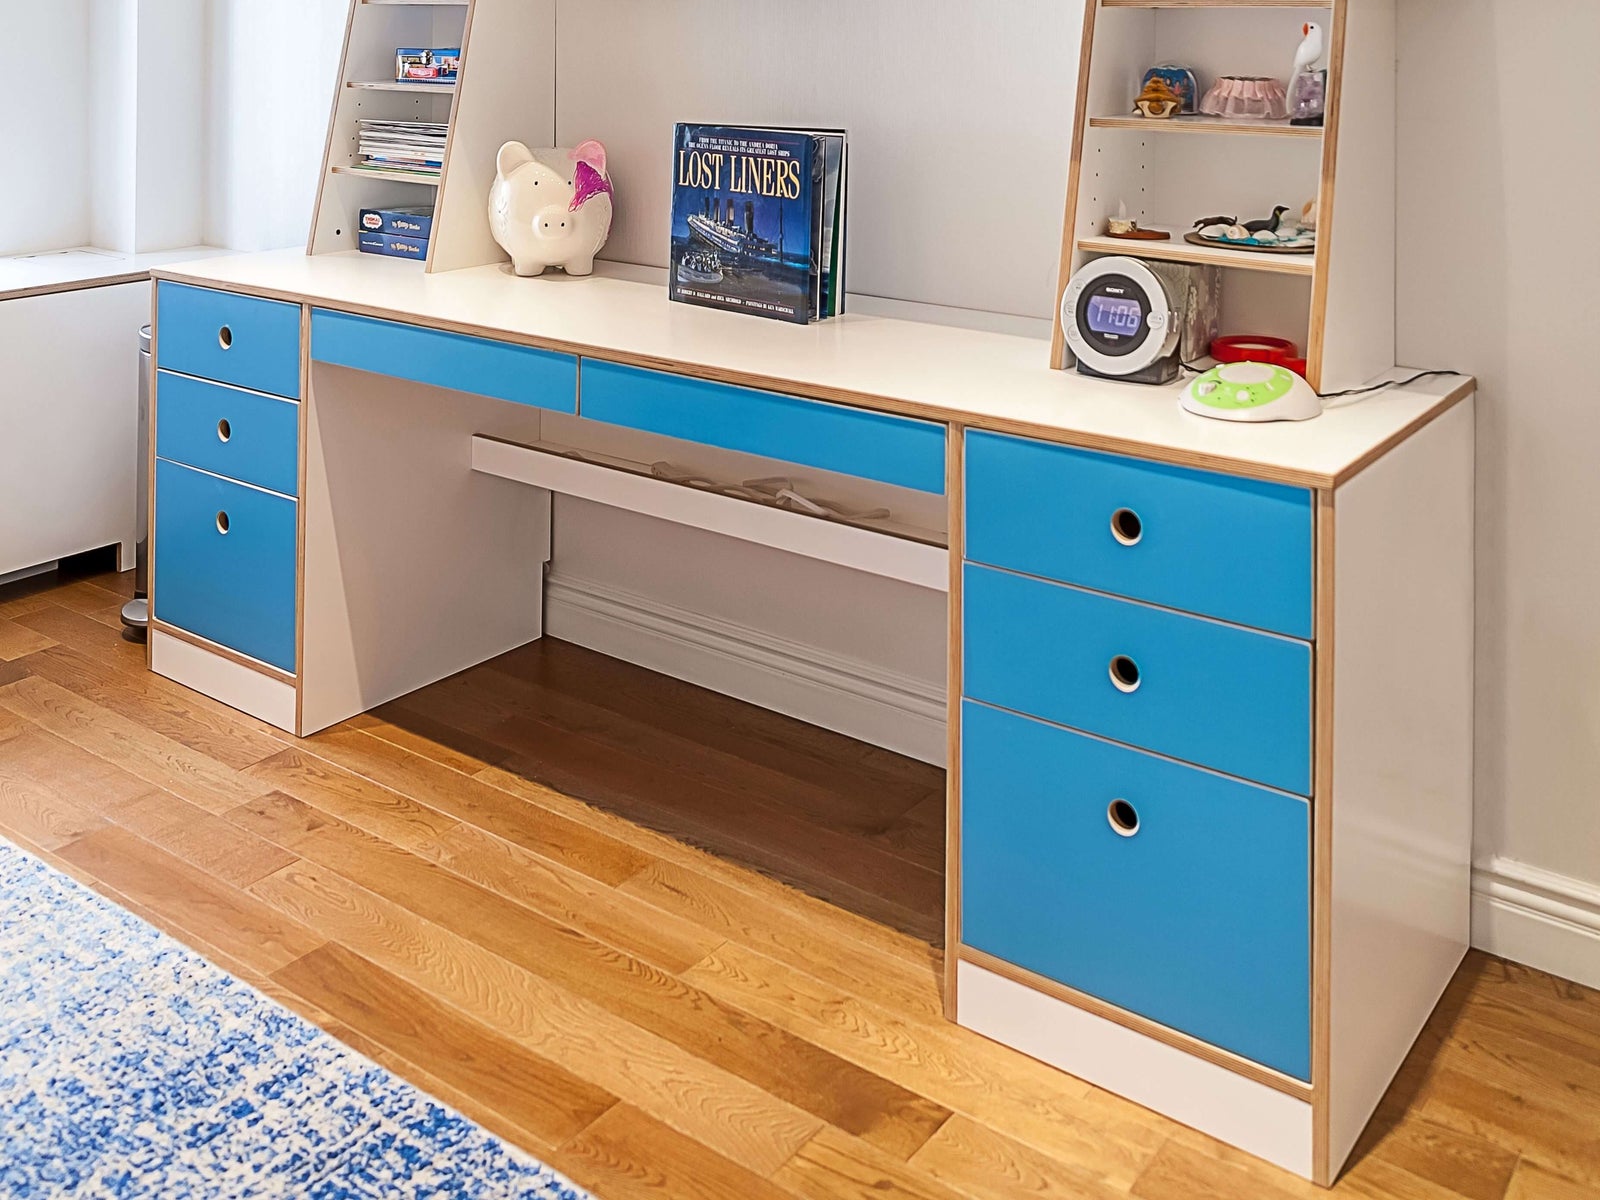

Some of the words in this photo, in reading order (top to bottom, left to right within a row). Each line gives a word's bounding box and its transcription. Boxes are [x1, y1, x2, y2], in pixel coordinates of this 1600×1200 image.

[679, 150, 723, 190] LOST
[730, 155, 800, 199] LINERS
[1097, 304, 1139, 328] 11:06
